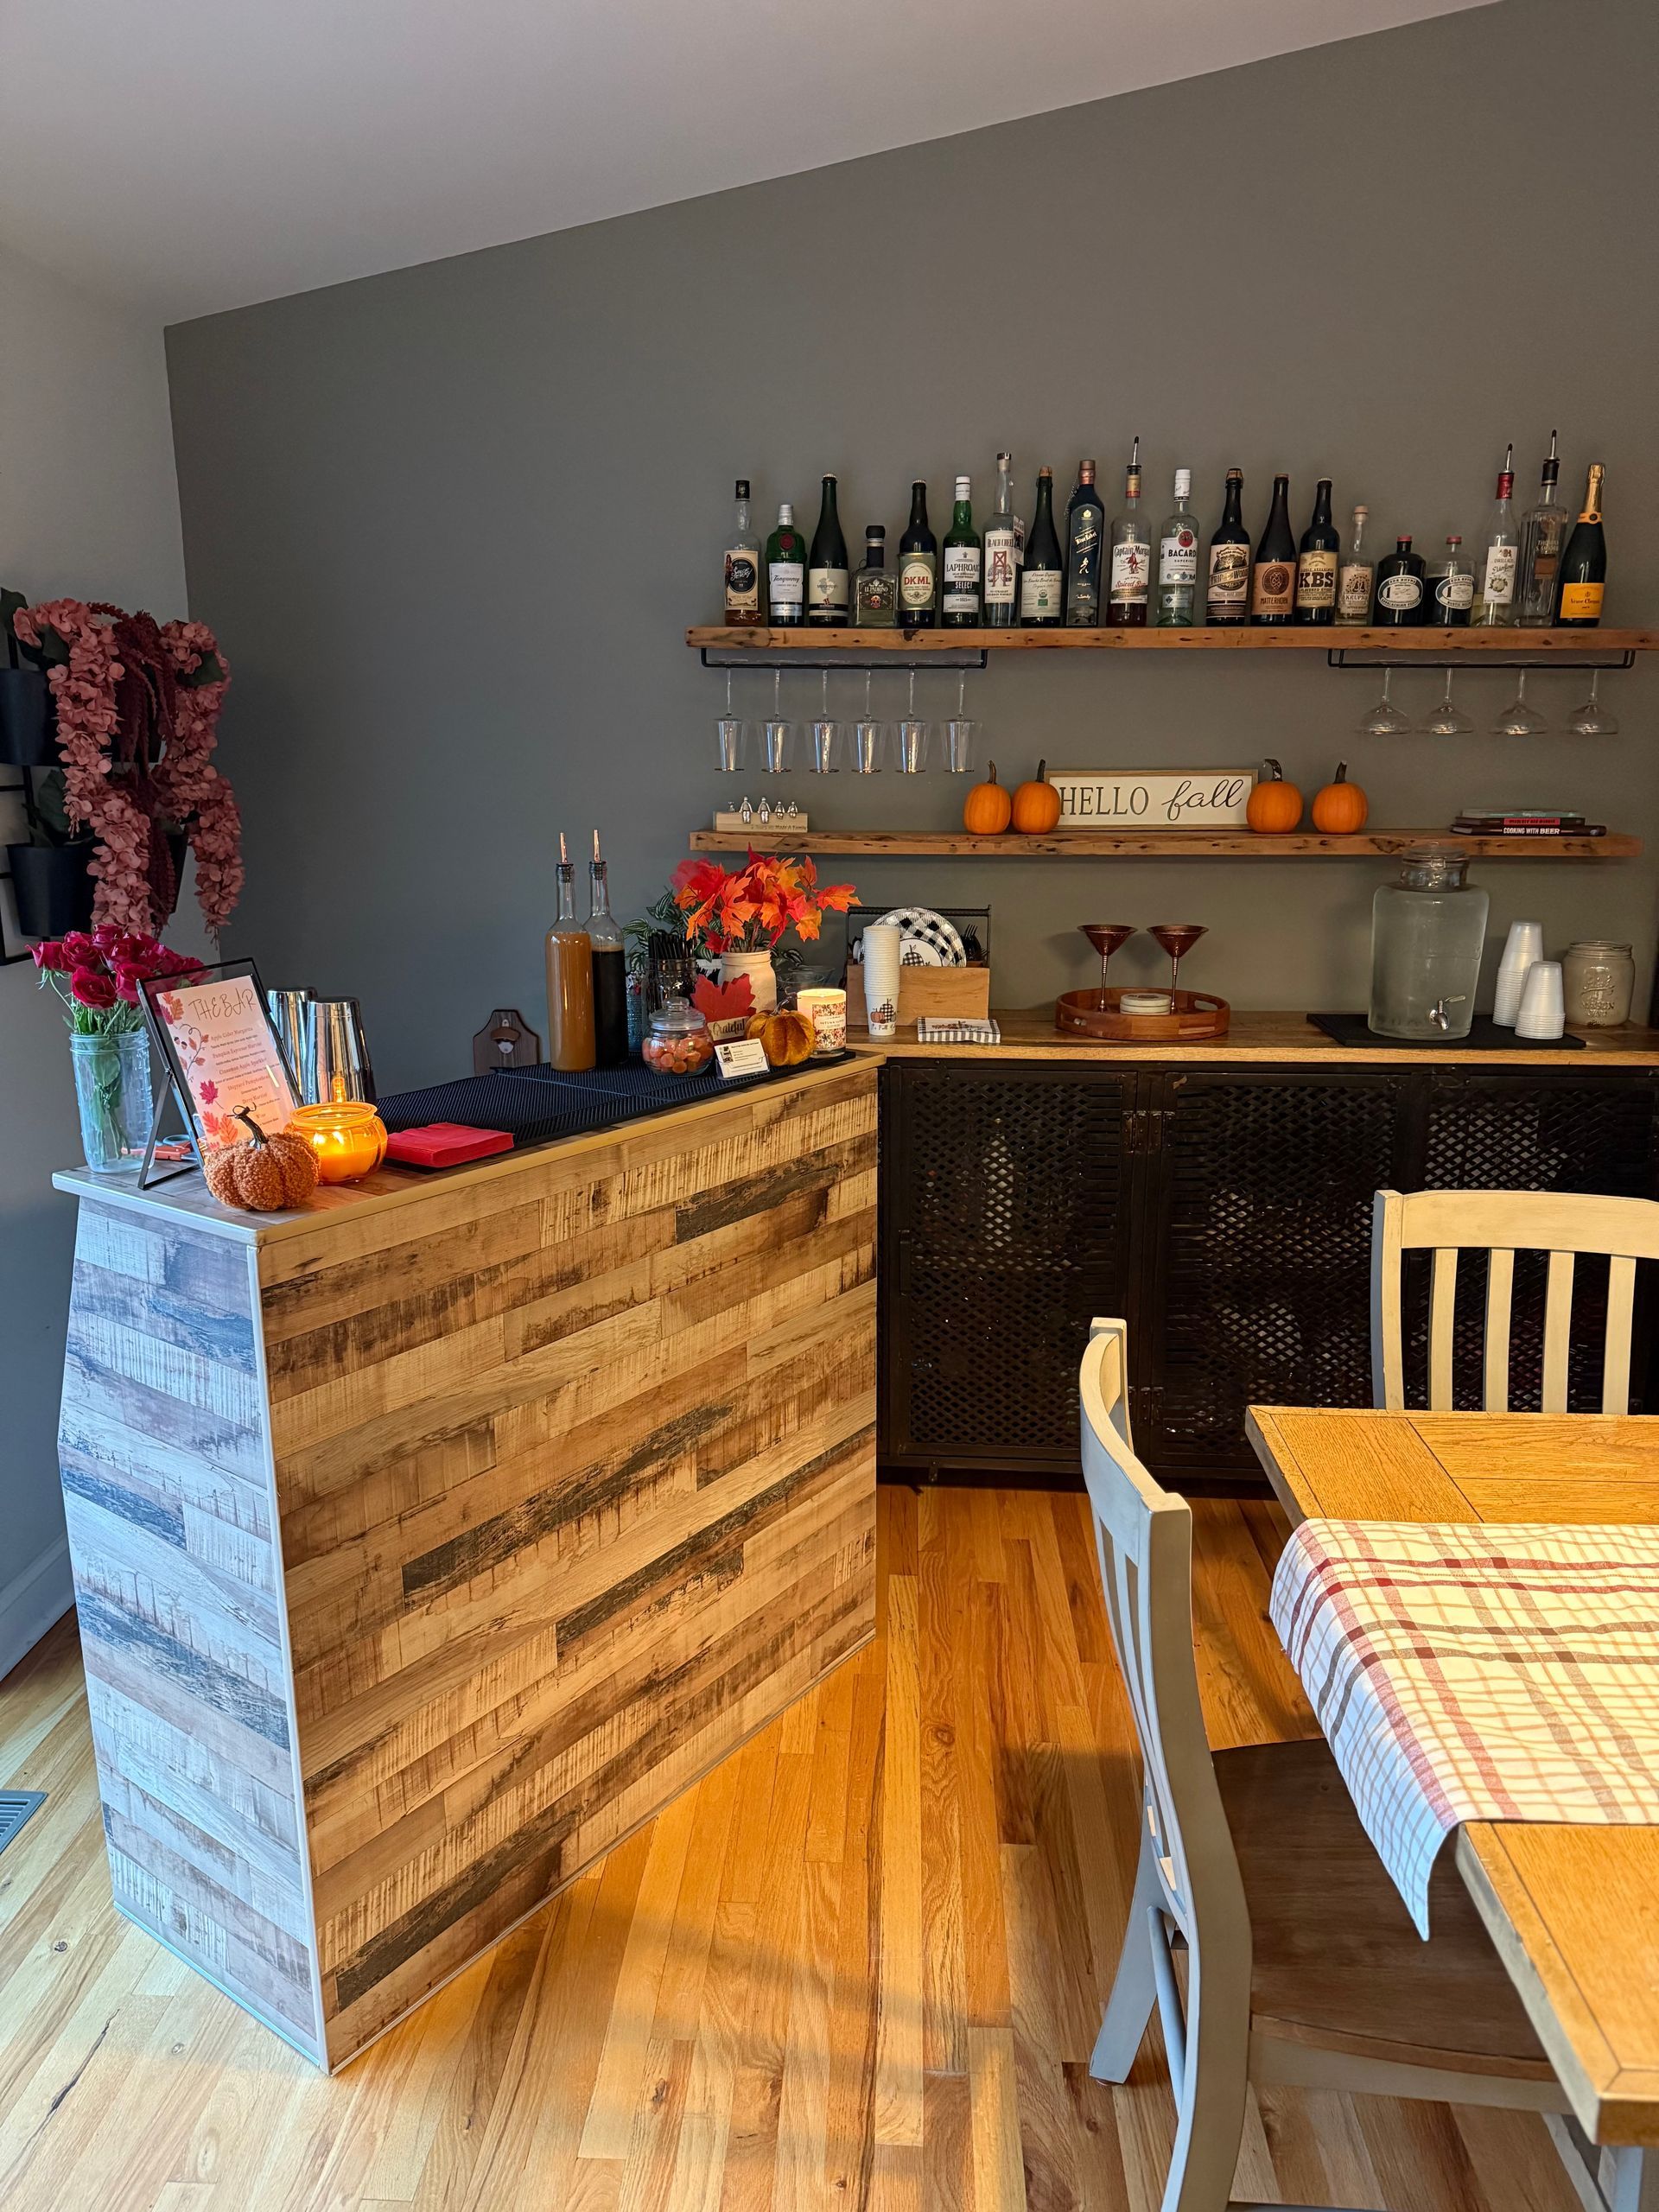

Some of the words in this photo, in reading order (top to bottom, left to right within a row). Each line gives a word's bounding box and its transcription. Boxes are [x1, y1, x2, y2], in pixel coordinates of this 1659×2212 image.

[1114, 546, 1134, 557] Captain
[1168, 549, 1197, 557] BACARD
[773, 575, 800, 583] Tanqueray
[904, 576, 931, 585] DKML
[1300, 571, 1334, 588] KBS
[1060, 785, 1149, 816] HELLO
[1161, 779, 1244, 821] fall
[713, 1018, 745, 1036] Grateful
